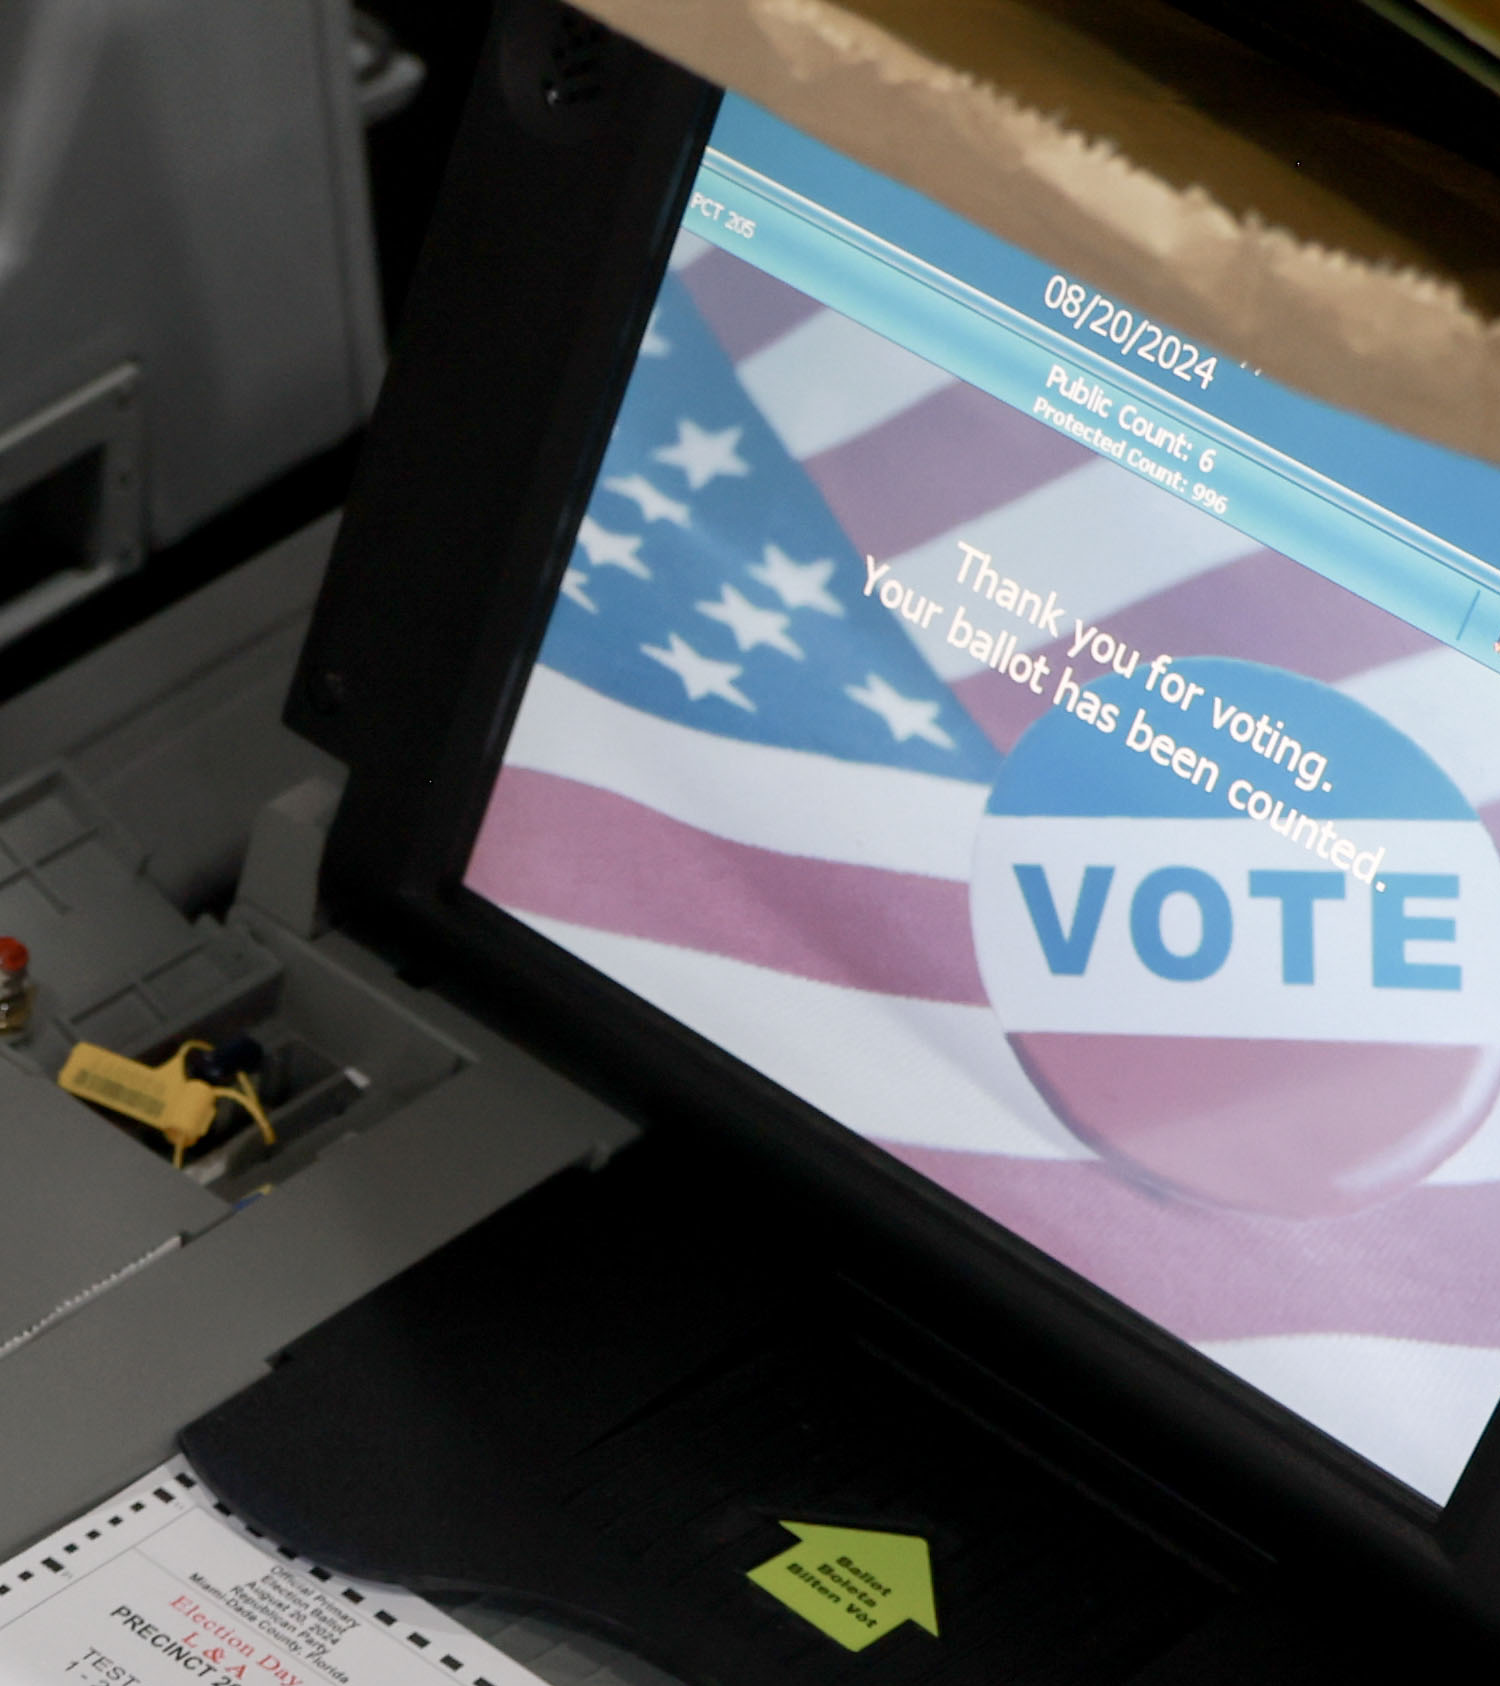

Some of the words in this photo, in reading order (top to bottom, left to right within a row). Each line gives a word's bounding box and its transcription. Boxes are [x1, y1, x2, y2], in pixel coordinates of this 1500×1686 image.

[692, 192, 725, 224] PCT
[724, 208, 755, 240] 205
[1044, 274, 1220, 391] 08/20/2024
[1046, 365, 1111, 419] Public
[1118, 404, 1191, 462] Count:
[1198, 448, 1216, 473] 6
[1033, 397, 1125, 457] Protected
[1126, 441, 1188, 495] Count:
[1192, 481, 1228, 515] 996
[956, 543, 1065, 642] Thank
[1067, 617, 1141, 686] you
[1137, 654, 1206, 714] for
[1211, 695, 1335, 794] voting.
[860, 555, 944, 630] Your
[944, 605, 1047, 697] ballot
[1053, 663, 1120, 734] has
[1125, 705, 1219, 789] been
[1227, 768, 1390, 893] counted.
[1012, 863, 1463, 991] VOTE
[787, 1563, 841, 1603] Bilten
[846, 1603, 878, 1629] Vòt
[818, 1563, 877, 1608] Boleta
[836, 1556, 892, 1597] Ballot
[110, 1605, 216, 1677] PRECINCT
[169, 1594, 257, 1658] Election
[181, 1632, 198, 1648] L
[202, 1646, 226, 1665] &
[226, 1662, 247, 1680] A
